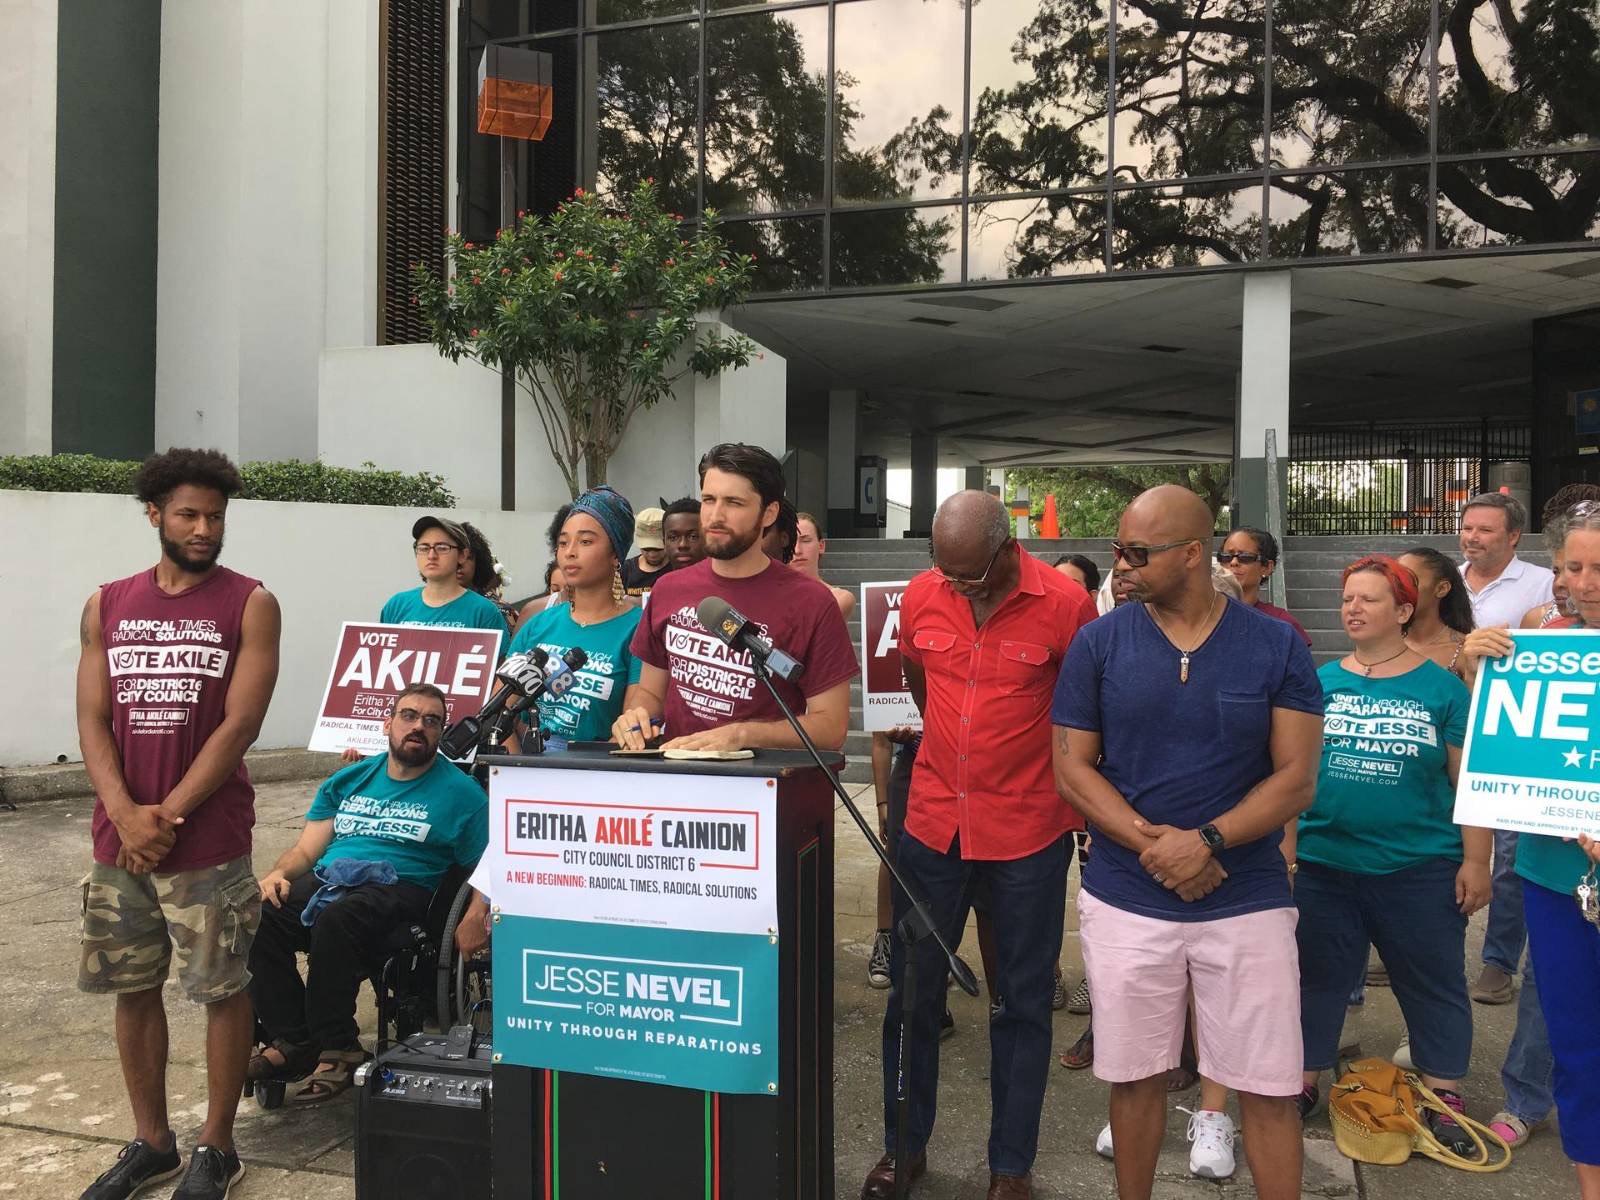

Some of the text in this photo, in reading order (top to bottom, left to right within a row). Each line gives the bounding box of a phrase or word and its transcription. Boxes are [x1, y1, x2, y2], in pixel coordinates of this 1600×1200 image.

[118, 619, 217, 633] RADICAL TIMES
[112, 631, 222, 644] RADICAL SOLUTIONS
[359, 632, 399, 647] VOTE
[669, 630, 711, 658] VOTE
[112, 649, 223, 672] VOTE AKILÉ
[337, 644, 488, 696] AKILÉ
[1492, 643, 1600, 676] Jesse
[517, 669, 543, 695] 10
[669, 655, 757, 689] FOR DISTRICT 6
[117, 679, 137, 691] FOR
[137, 678, 195, 691] DISTRICT
[551, 672, 573, 695] 8
[671, 668, 753, 700] CITY COUNCIL
[354, 694, 383, 707] Eritha
[868, 697, 910, 705] RADICAL
[1332, 693, 1424, 710] UNITY THROUGH
[1482, 678, 1600, 742] NE
[352, 706, 366, 715] For
[366, 706, 383, 718] City
[1325, 702, 1431, 722] REPARATIONS
[320, 720, 380, 732] RADICAL TIMES
[1369, 721, 1430, 740] JESSE
[1323, 736, 1419, 757] FOR MAYOR
[1332, 756, 1398, 772] JESSE NEVEL
[350, 794, 382, 807] UNITY
[1471, 779, 1600, 803] UNITY THROUG
[339, 799, 429, 820] REPARATIONS
[1541, 805, 1600, 821] JESSENE
[372, 821, 422, 837] JESSE
[516, 811, 746, 852] ERITHA AKILÉ CAINION
[563, 850, 696, 872] CITY COUNCIL DISTRICT 6
[506, 871, 758, 900] A NEW BEGINNING: RADICAL TIMES, RADICAL SOLUTIONS
[535, 965, 731, 1008] JESSE NEVEL
[586, 1001, 675, 1022] FOR MAYOR
[507, 1016, 763, 1055] UNITY THROUGH REPARATIONS
